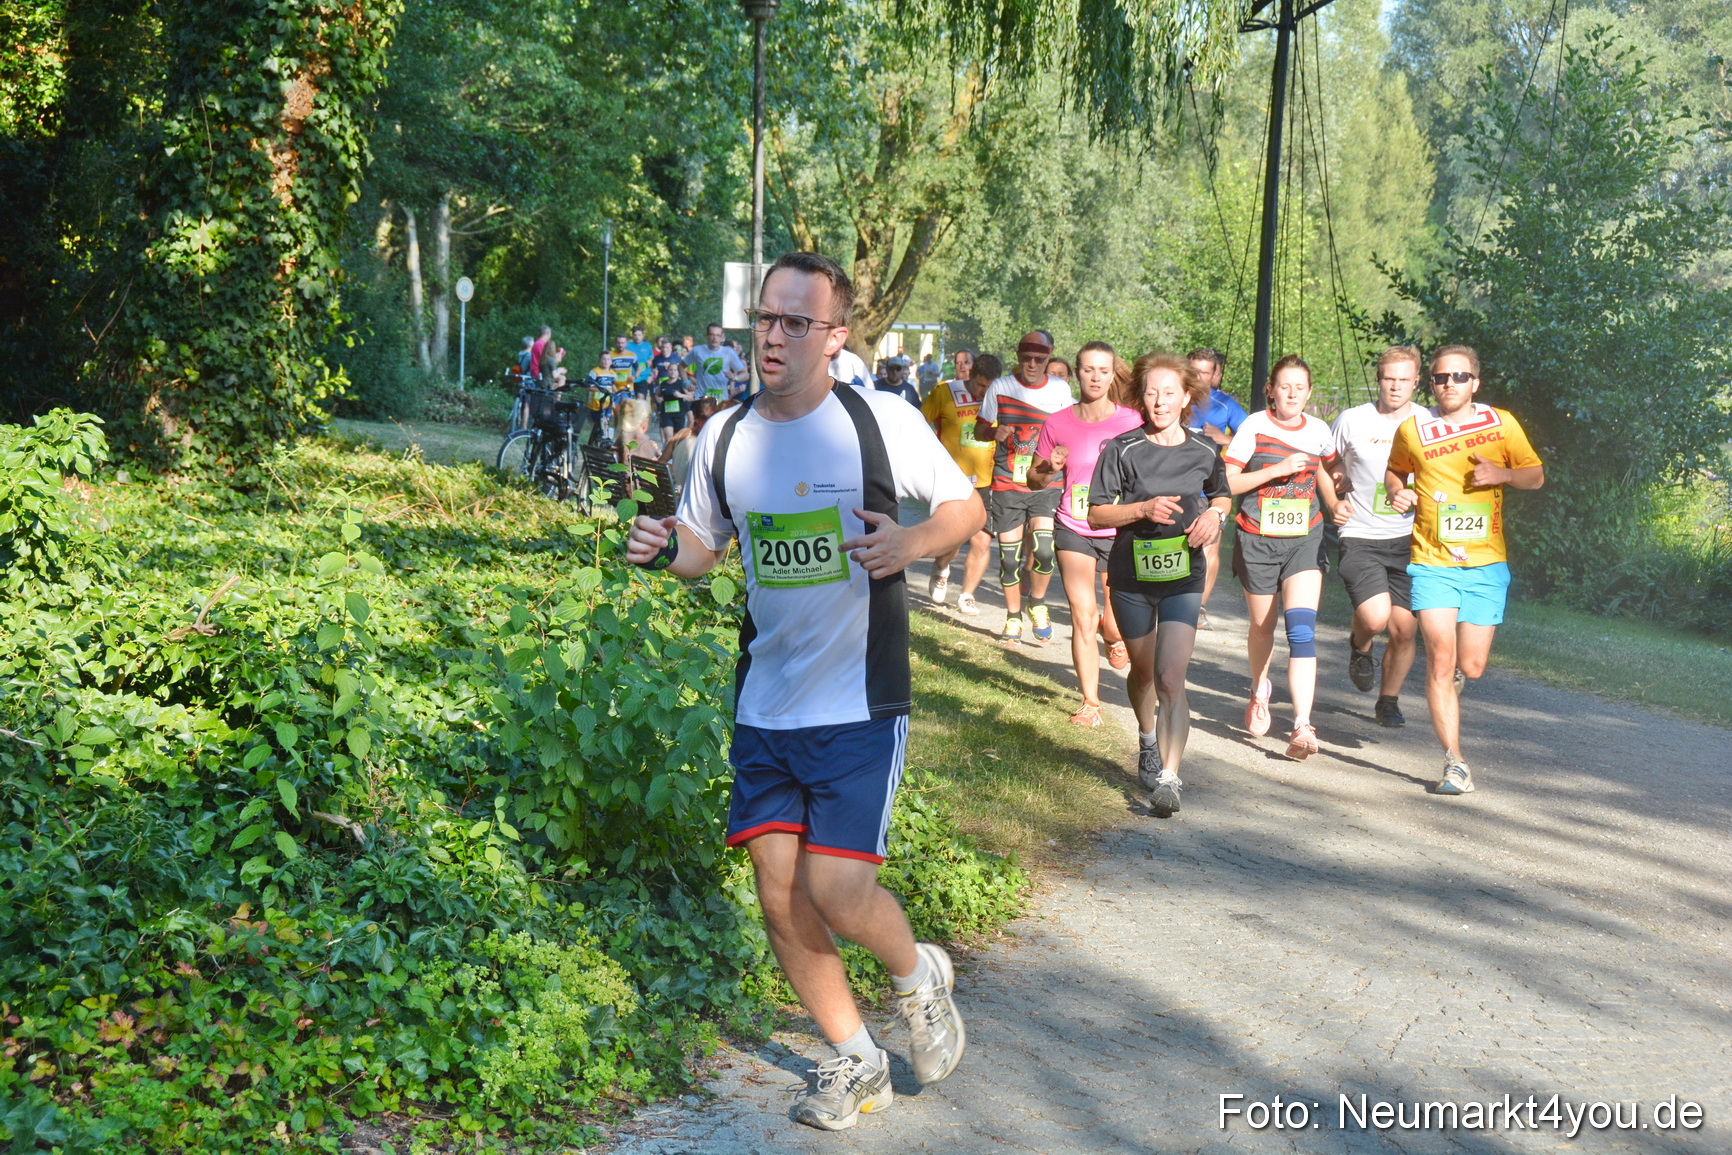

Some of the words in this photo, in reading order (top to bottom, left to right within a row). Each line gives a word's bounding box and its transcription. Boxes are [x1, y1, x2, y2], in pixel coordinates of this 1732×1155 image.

[957, 408, 979, 418] MAX
[1423, 442, 1461, 460] MAX
[1465, 431, 1505, 448] BÖGL
[1268, 511, 1303, 525] 1893
[1445, 517, 1483, 530] 1224
[760, 537, 832, 567] 2006
[1141, 551, 1183, 570] 1657
[772, 567, 790, 575] Adler
[793, 565, 822, 574] Michael
